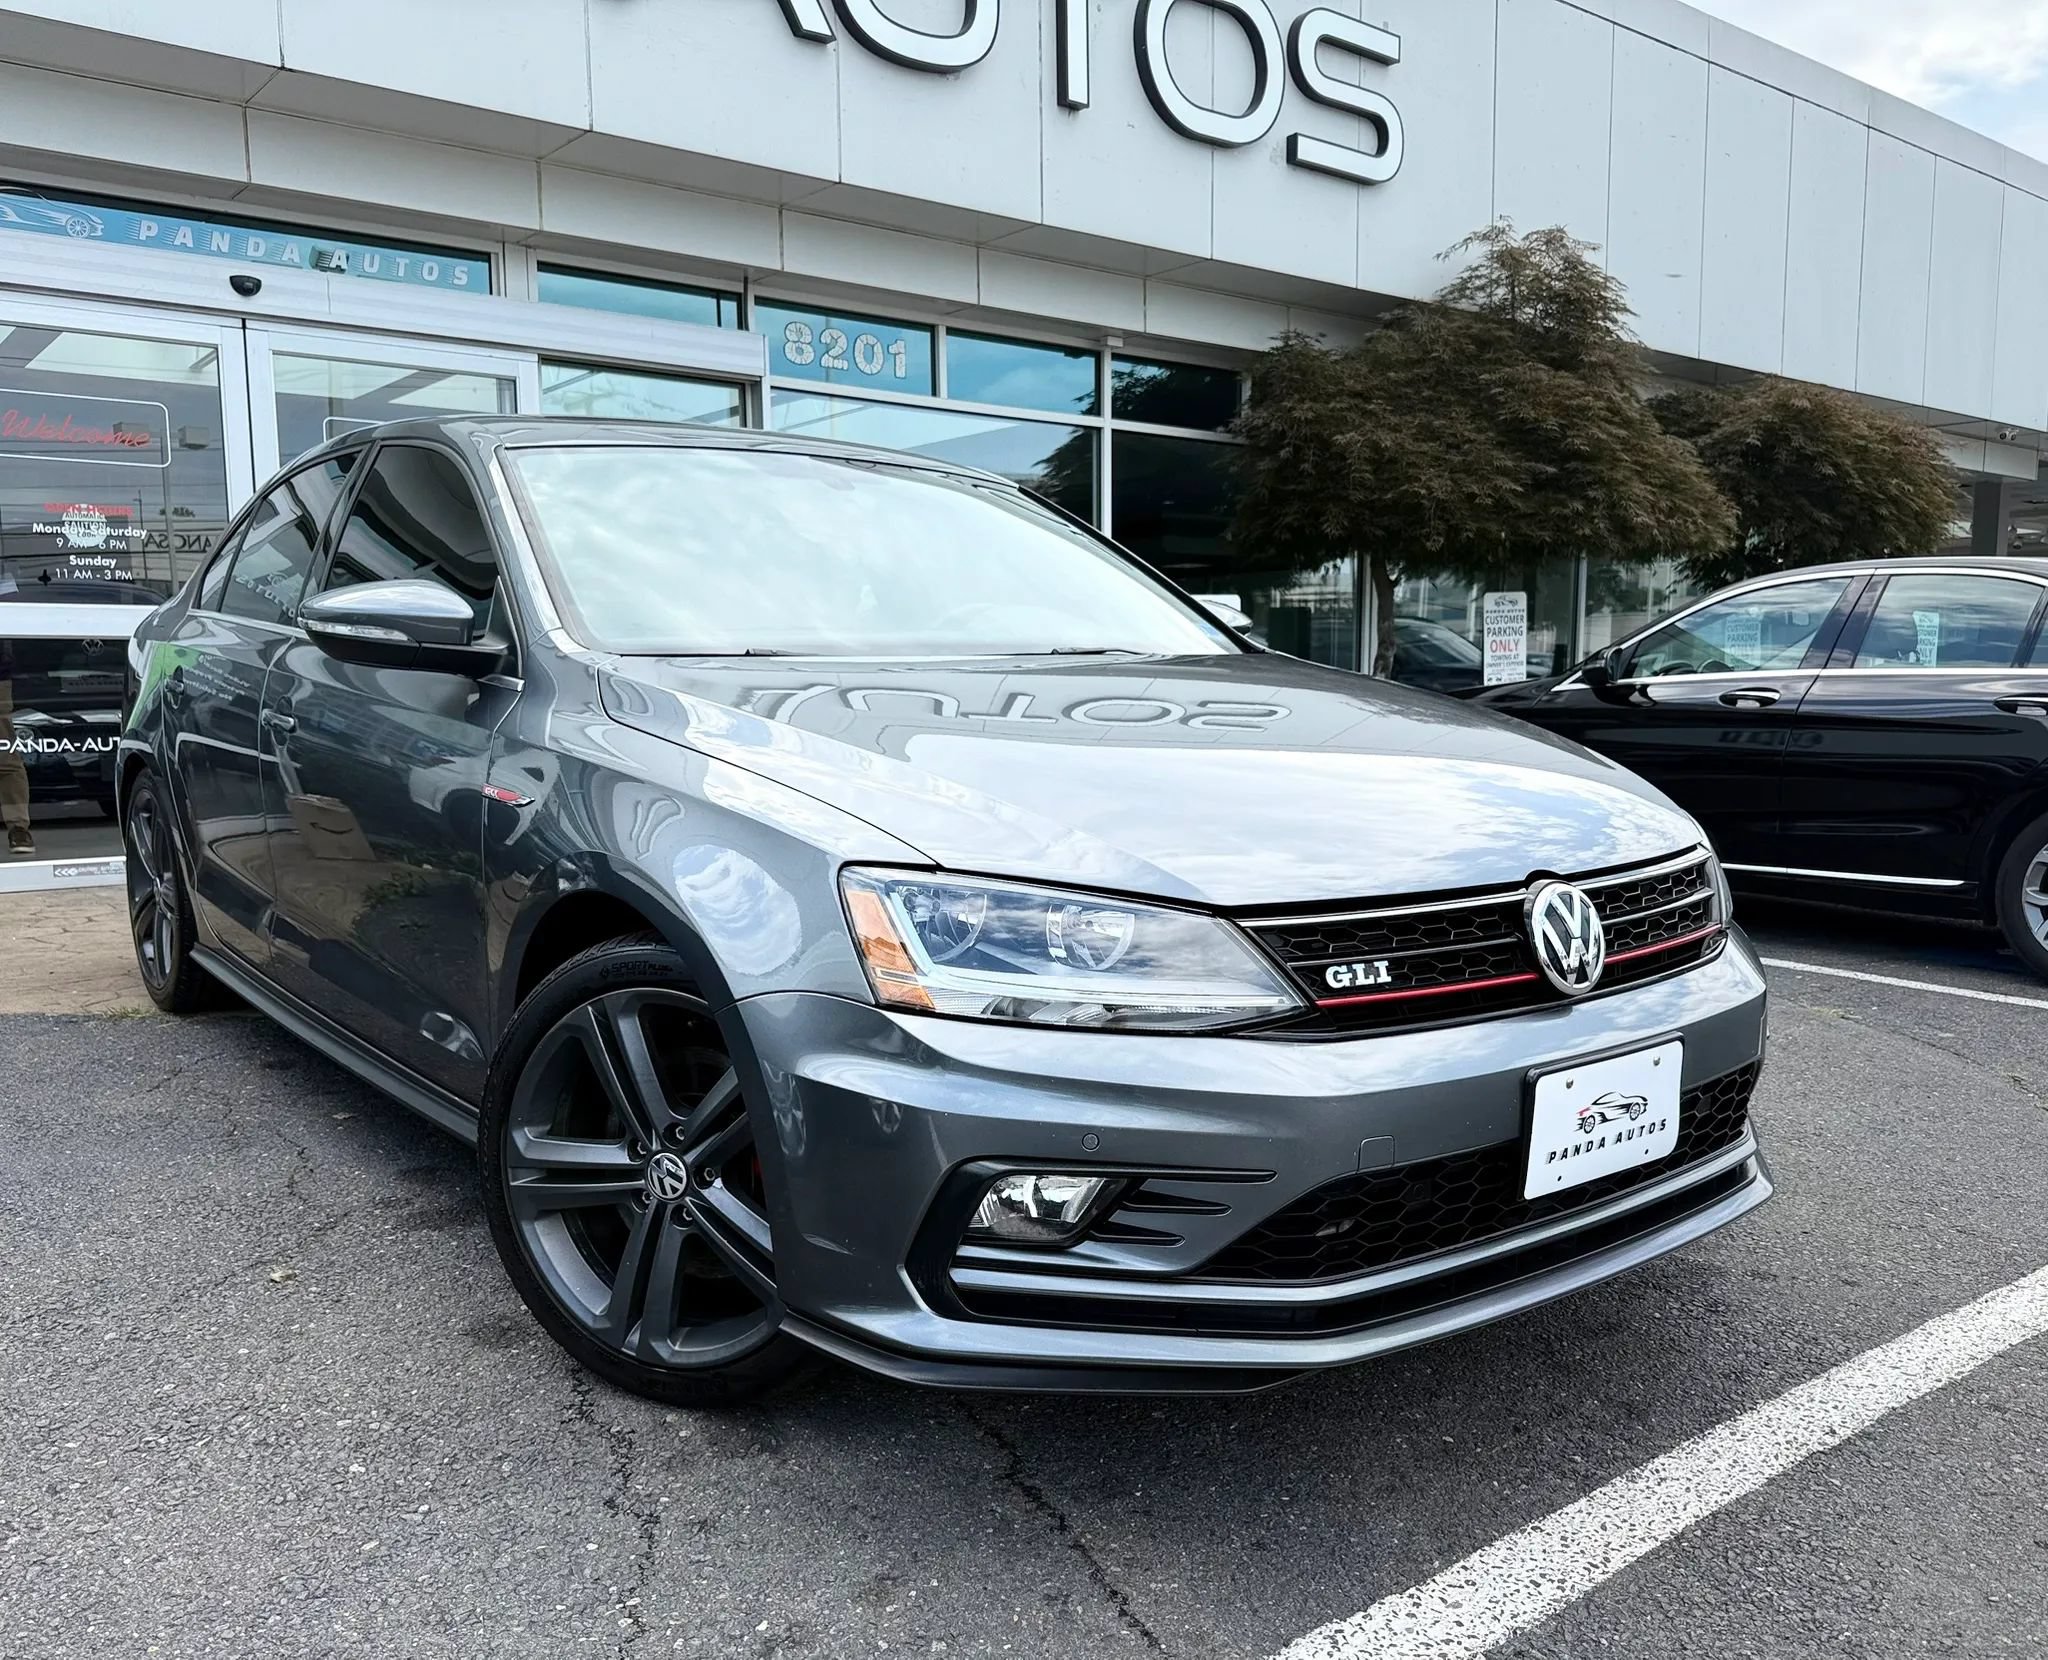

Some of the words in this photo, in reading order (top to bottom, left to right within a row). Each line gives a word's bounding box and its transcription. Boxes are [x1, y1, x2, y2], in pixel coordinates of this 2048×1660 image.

[138, 219, 300, 264] PANDA
[328, 248, 469, 286] AUTOS
[784, 321, 907, 379] 8201
[1, 409, 151, 448] Welcome
[56, 537, 64, 549] 9
[67, 539, 88, 549] AM
[98, 540, 106, 550] 6
[109, 540, 128, 550] PM
[69, 555, 118, 568] Sunday
[56, 568, 69, 579] 11
[73, 570, 93, 580] AM
[104, 570, 112, 580] 3
[115, 571, 133, 581] PM
[1485, 614, 1525, 625] CUSTOMER
[1486, 626, 1524, 637] PARKING
[1489, 639, 1520, 653] ONLY
[1325, 960, 1393, 989] GLI
[1546, 1136, 1606, 1165] PANDA
[1612, 1118, 1668, 1146] AUTOS
